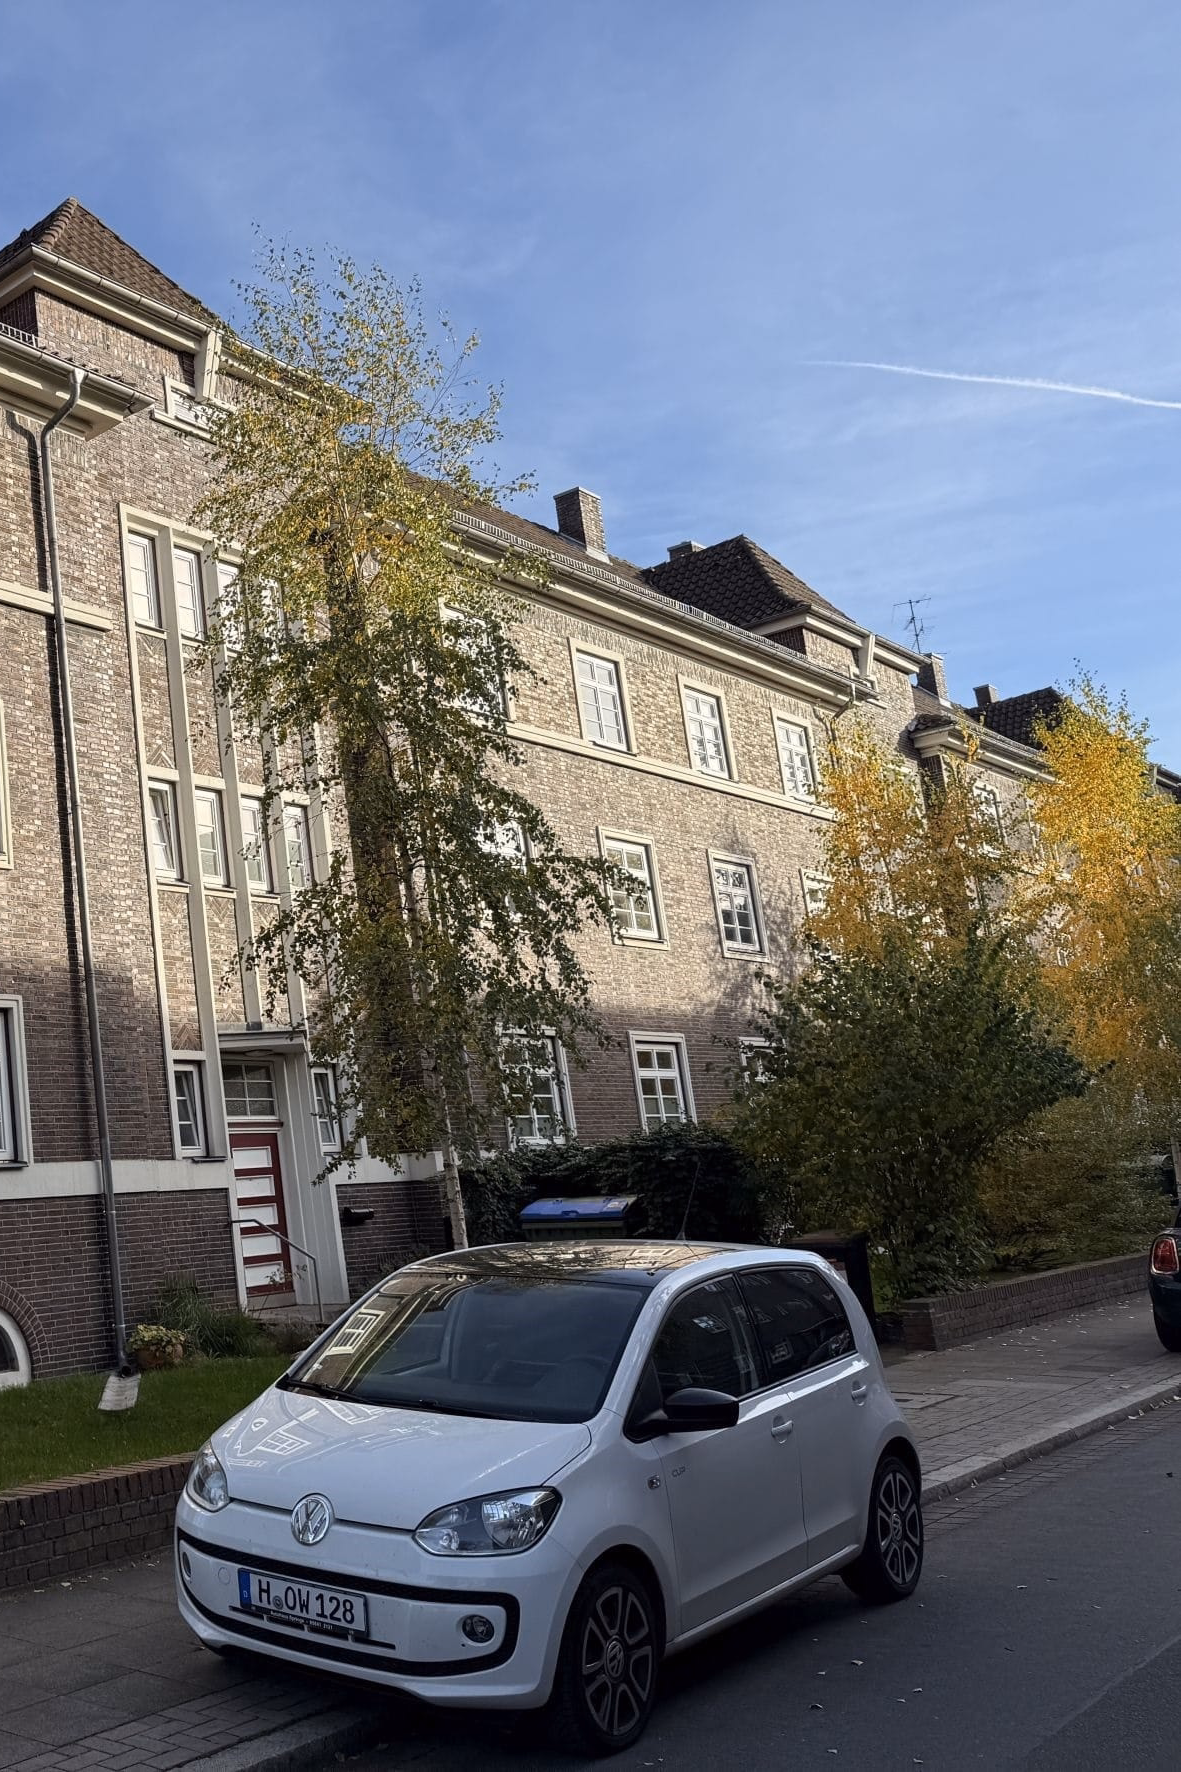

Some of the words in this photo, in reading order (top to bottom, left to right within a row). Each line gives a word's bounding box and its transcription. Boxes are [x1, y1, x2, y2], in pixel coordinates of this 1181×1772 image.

[258, 1579, 271, 1605] H
[285, 1586, 310, 1614] OW
[315, 1593, 355, 1624] 128
